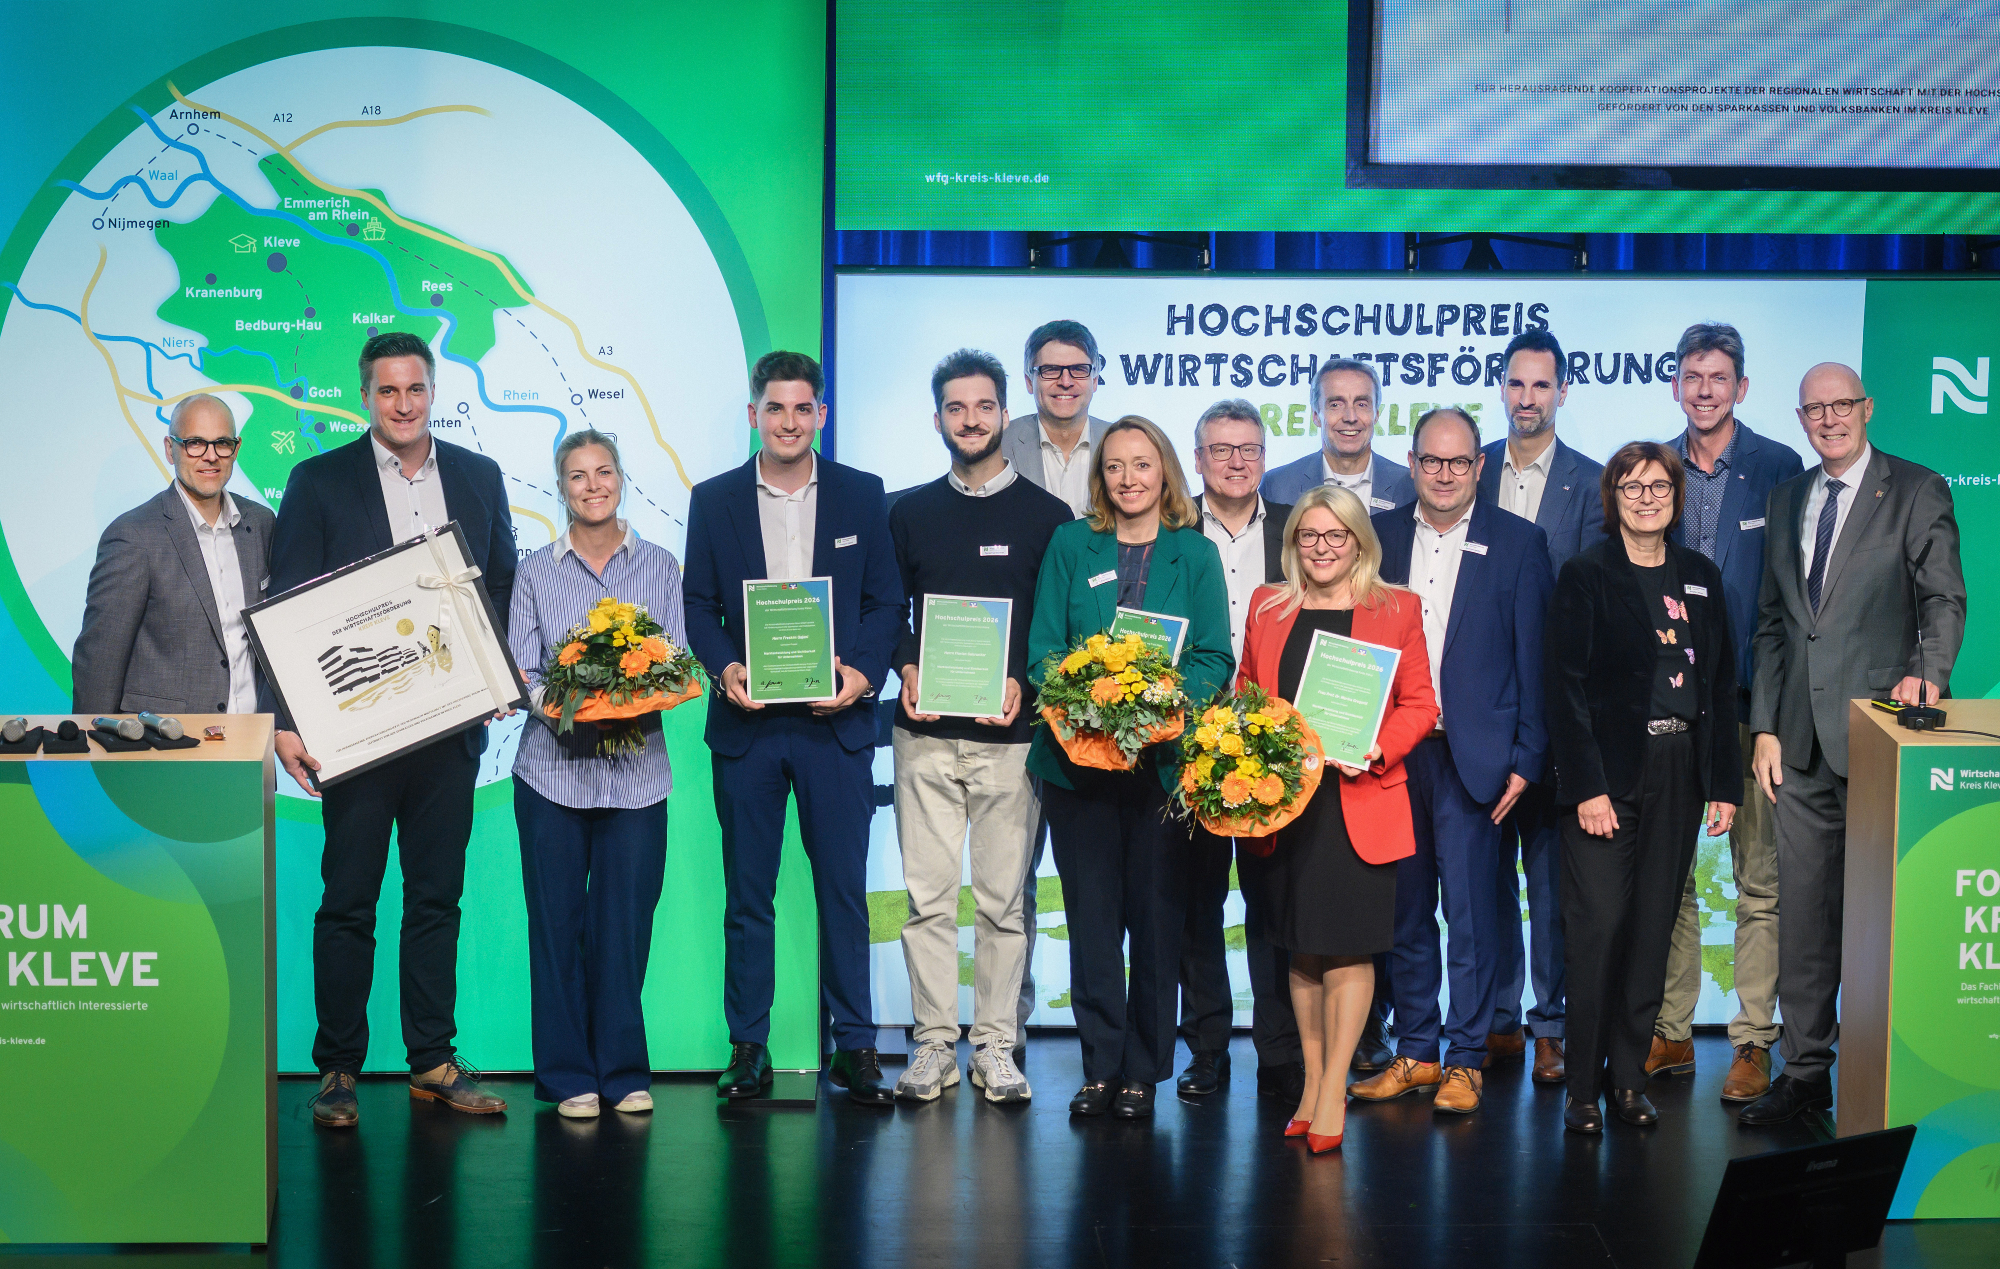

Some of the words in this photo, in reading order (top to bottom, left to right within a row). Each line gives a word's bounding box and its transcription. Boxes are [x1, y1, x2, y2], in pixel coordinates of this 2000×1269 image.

[1500, 84, 1595, 93] HERAUSRAGENDE
[1600, 85, 1741, 95] KOOPERATIONSPROJEKTE
[1745, 86, 1766, 95] DER
[1769, 87, 1839, 96] REGIONALEN
[1843, 87, 1913, 97] WIRTSCHAFT
[1918, 88, 1936, 97] MIT
[1940, 88, 1961, 97] DER
[169, 109, 221, 120] Arnhem
[361, 105, 382, 116] A18
[1665, 103, 1689, 112] VON
[1692, 103, 1713, 113] DEN
[1717, 104, 1789, 113] SPARKASSEN
[1793, 104, 1816, 113] UND
[1820, 105, 1900, 114] VOLKSBANKEN
[1904, 106, 1916, 114] IM
[1920, 105, 1951, 115] KREIS
[1955, 106, 1989, 115] KLEVE
[273, 113, 293, 123] A12
[148, 170, 178, 181] Waal
[925, 171, 1050, 185] wfg-kreis-kleve.de
[284, 197, 350, 208] Emmerich
[308, 212, 328, 221] am
[331, 209, 369, 221] Rhein
[108, 218, 170, 231] Nijmegen
[263, 236, 301, 248] Kleve
[421, 281, 453, 292] Rees
[185, 287, 263, 300] Kranenburg
[352, 313, 395, 324] Kalkar
[1166, 302, 1550, 337] HOCHSCHULPREIS
[235, 319, 322, 332] Bedburg-Hau
[162, 337, 195, 348] Niers
[598, 346, 613, 356] A3
[309, 387, 342, 398] Goch
[503, 390, 539, 400] Rhein
[588, 389, 624, 400] Wesel
[329, 421, 370, 433] Weeze
[427, 418, 461, 428] anten
[756, 597, 803, 606] Hochschulpreis
[803, 596, 820, 604] 2026
[934, 614, 981, 623] Hochschulpreis
[1158, 634, 1172, 642] 2026
[1320, 652, 1367, 669] Hochschulpreis
[1367, 664, 1384, 673] 2026
[1960, 781, 1982, 790] Kreis
[8, 951, 159, 987] KLEVE
[1961, 982, 1977, 991] Das
[1, 1000, 76, 1010] wirtschaftlich
[78, 1001, 149, 1011] Interessierte
